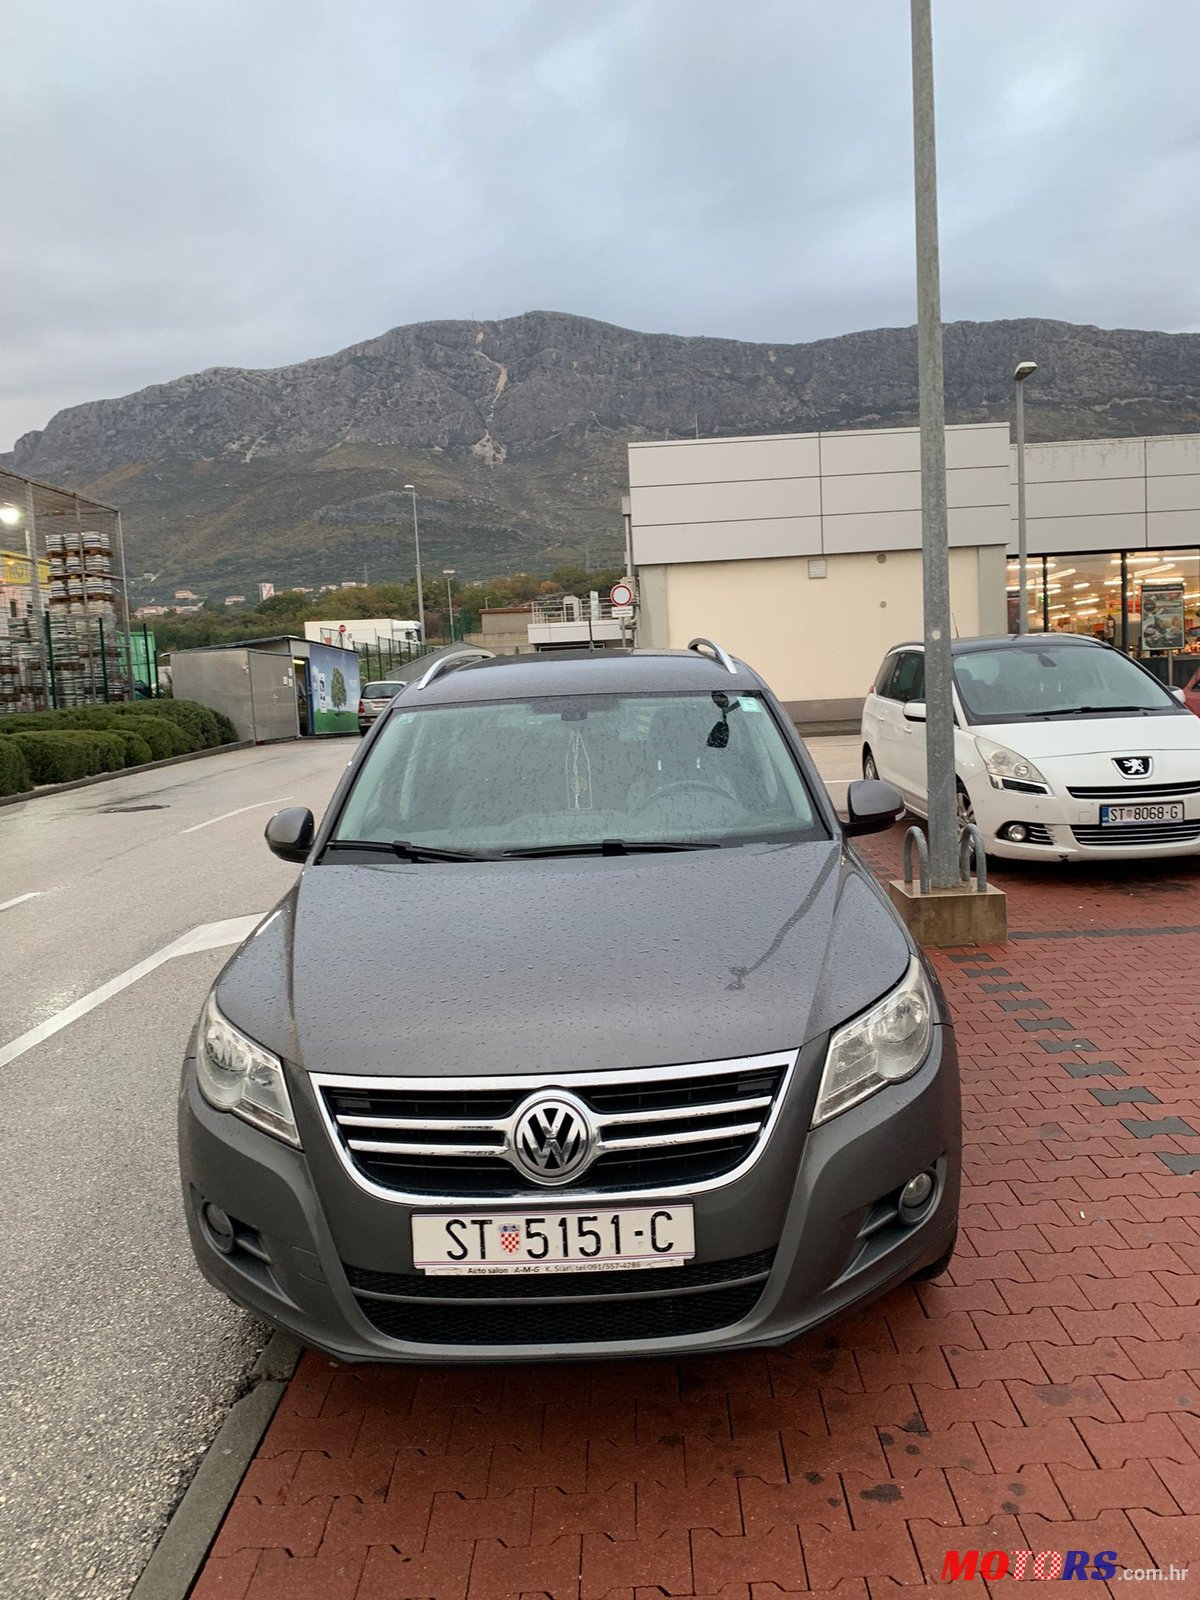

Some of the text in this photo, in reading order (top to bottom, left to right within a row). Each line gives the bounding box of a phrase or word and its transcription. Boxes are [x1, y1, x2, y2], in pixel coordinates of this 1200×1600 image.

[1110, 805, 1178, 822] ST 8068-G
[445, 1210, 674, 1261] ST 5151-C
[488, 1266, 508, 1274] salon
[513, 1265, 540, 1273] A-M-G
